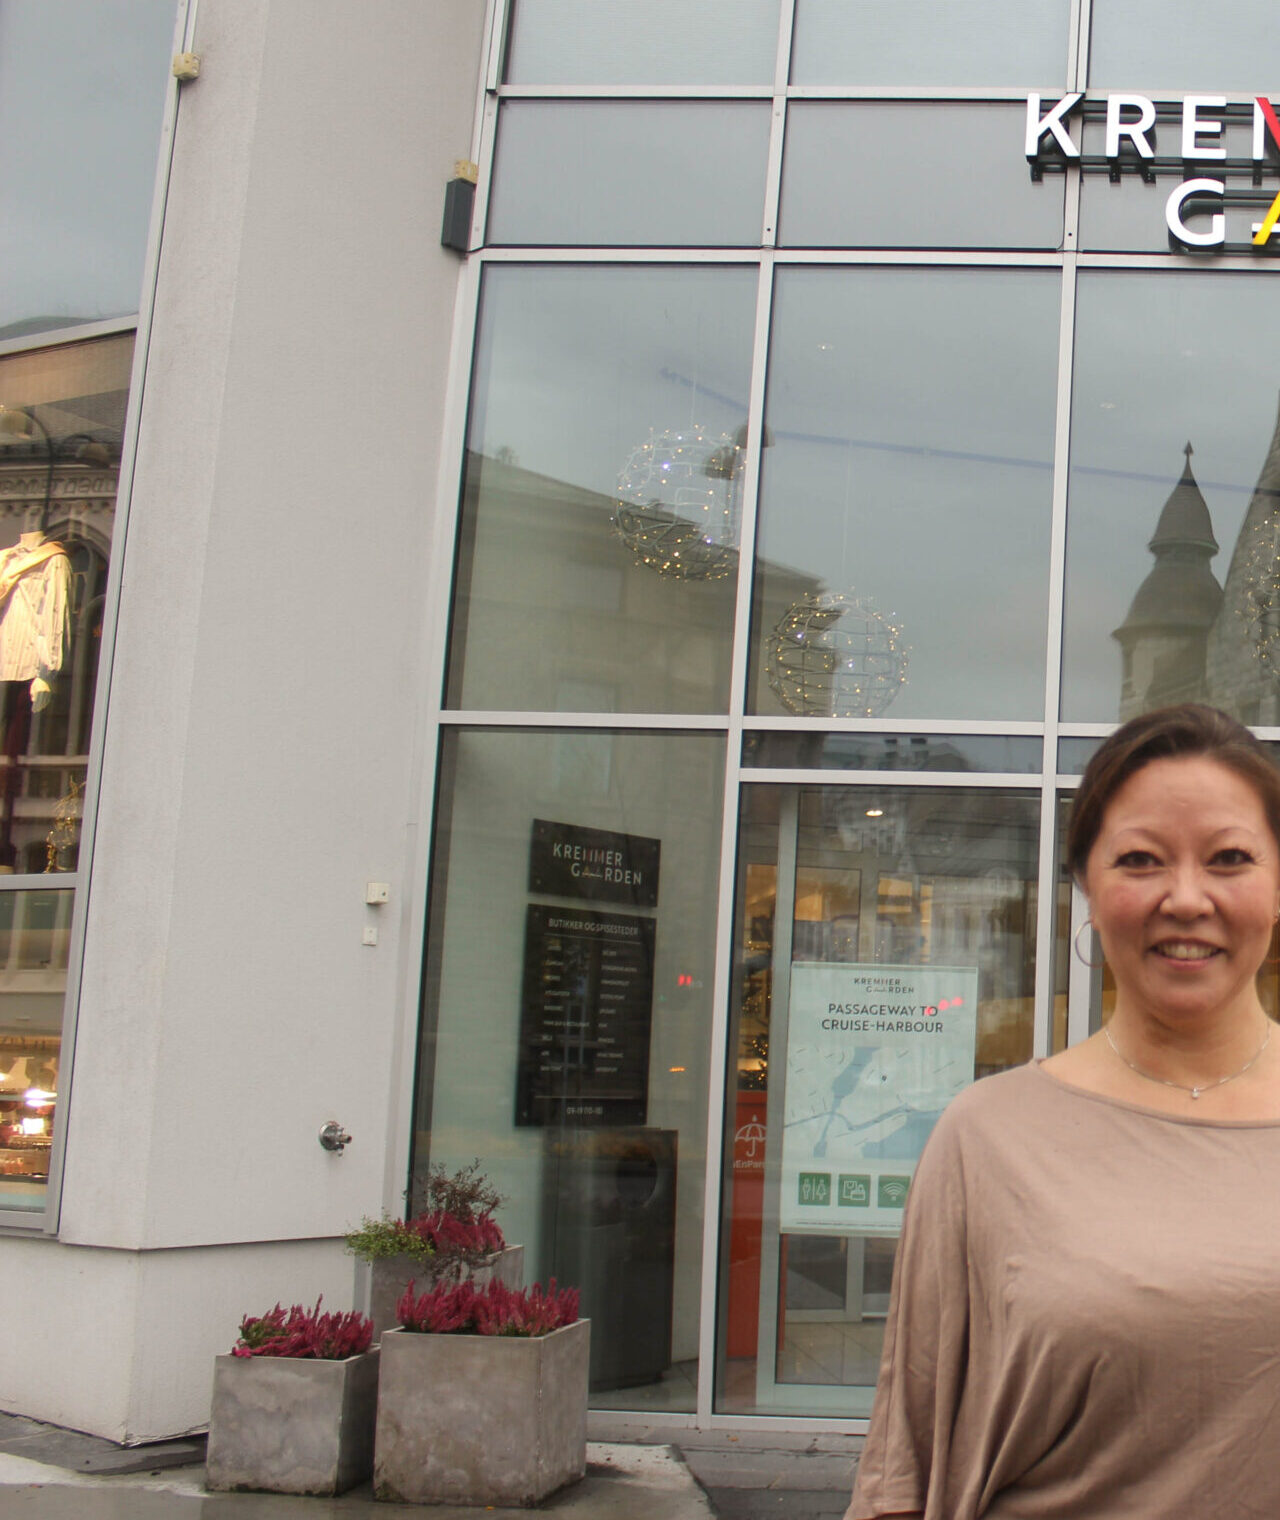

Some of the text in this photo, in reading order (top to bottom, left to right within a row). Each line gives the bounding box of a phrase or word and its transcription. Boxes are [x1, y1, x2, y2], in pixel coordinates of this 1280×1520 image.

[548, 918, 583, 930] BUTIKKER
[828, 1003, 939, 1018] PASSAGEWAY TO
[821, 1018, 944, 1034] CRUISE-HARBOUR
